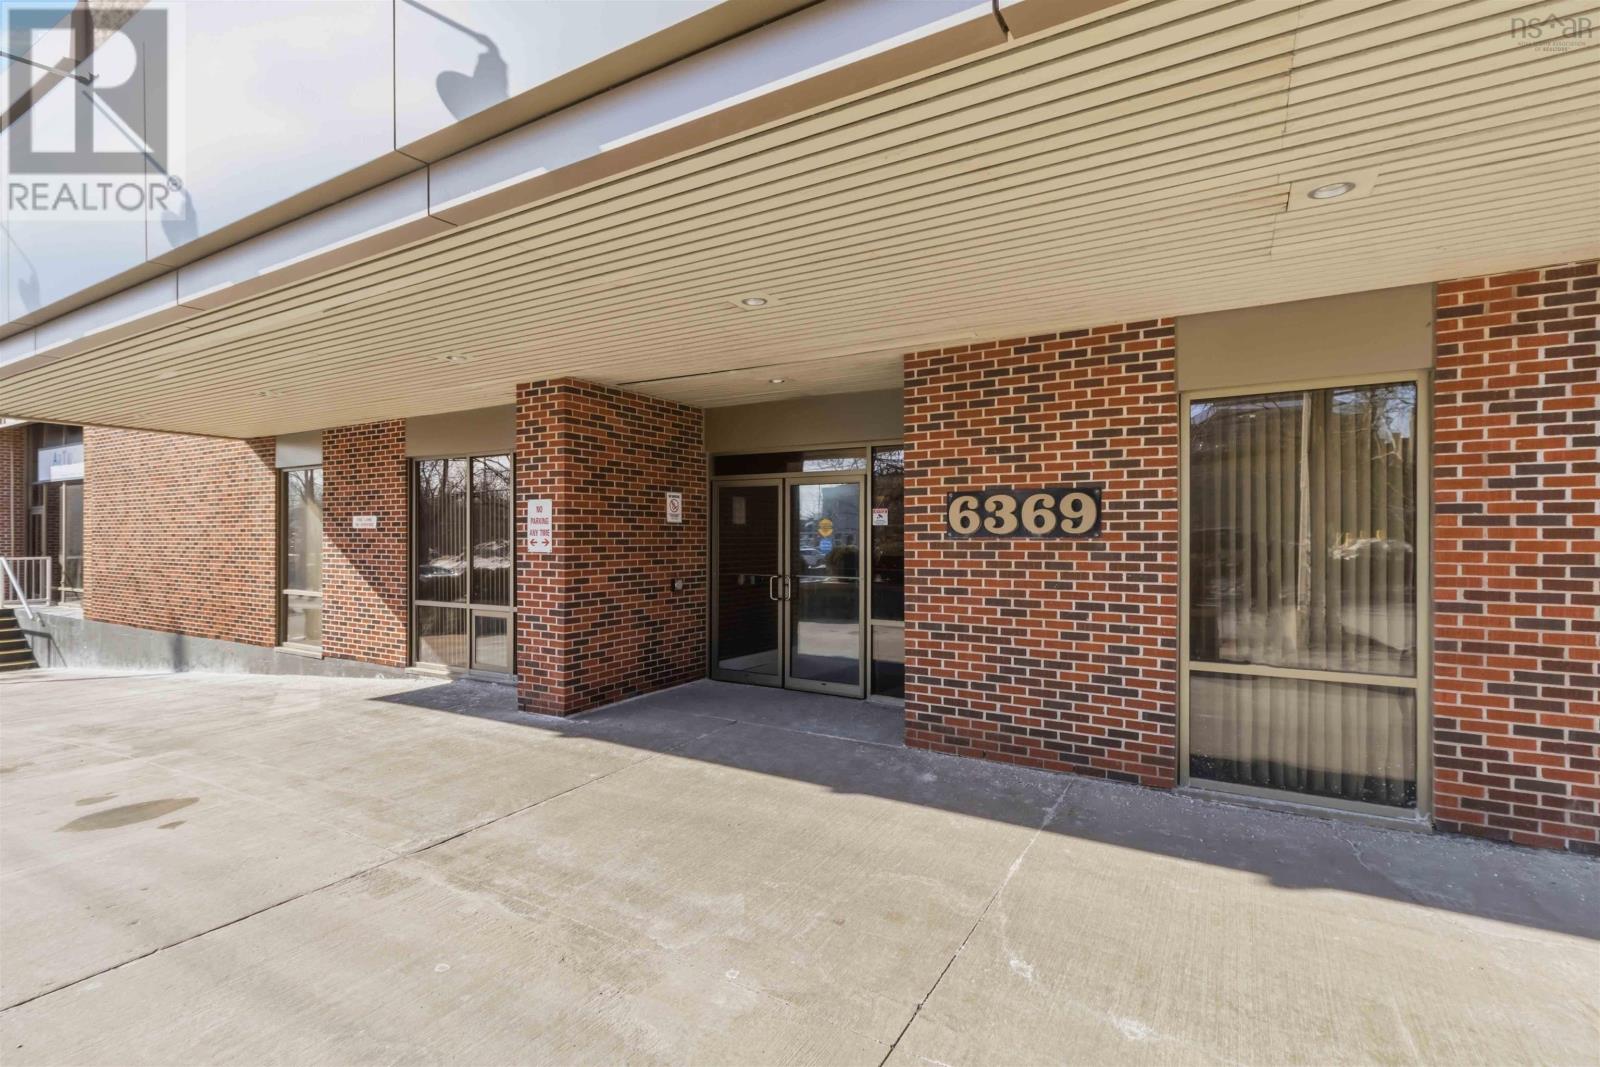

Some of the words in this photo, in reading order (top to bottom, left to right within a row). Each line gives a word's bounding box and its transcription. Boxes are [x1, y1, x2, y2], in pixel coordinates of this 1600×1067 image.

[535, 505, 544, 513] NO
[949, 492, 1097, 535] 6369
[530, 517, 550, 525] PARKING
